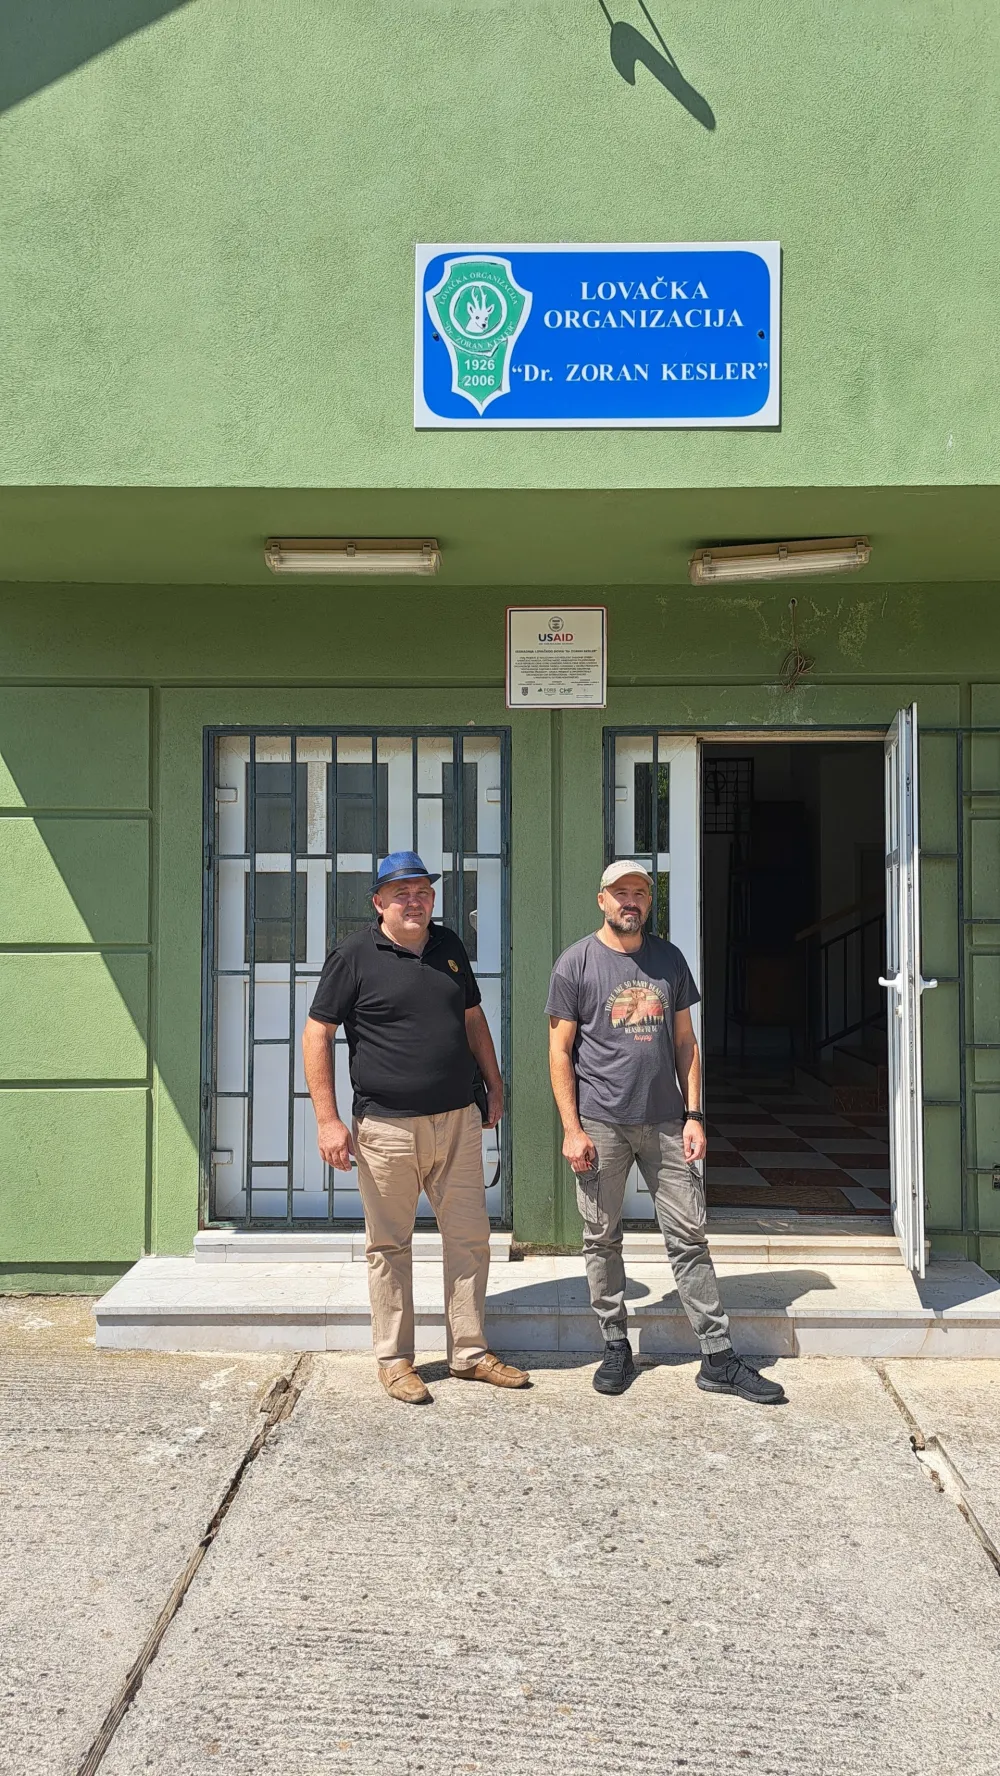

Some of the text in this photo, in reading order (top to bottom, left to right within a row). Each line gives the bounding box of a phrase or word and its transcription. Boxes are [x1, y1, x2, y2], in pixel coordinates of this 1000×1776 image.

[440, 272, 518, 305] LOVAČKA ORGANIZACIJA
[581, 276, 709, 300] LOVAČKA
[543, 308, 744, 329] ORGANIZACIJA
[455, 336, 483, 349] ZORAN
[464, 359, 495, 371] 1926
[566, 363, 649, 382] ZORAN
[463, 375, 495, 386] 2006
[538, 633, 574, 642] USAID
[604, 993, 617, 1012] THERE
[613, 984, 625, 995] ARE
[624, 980, 632, 988] SO
[632, 979, 649, 988] MANY
[634, 1034, 653, 1042] happy
